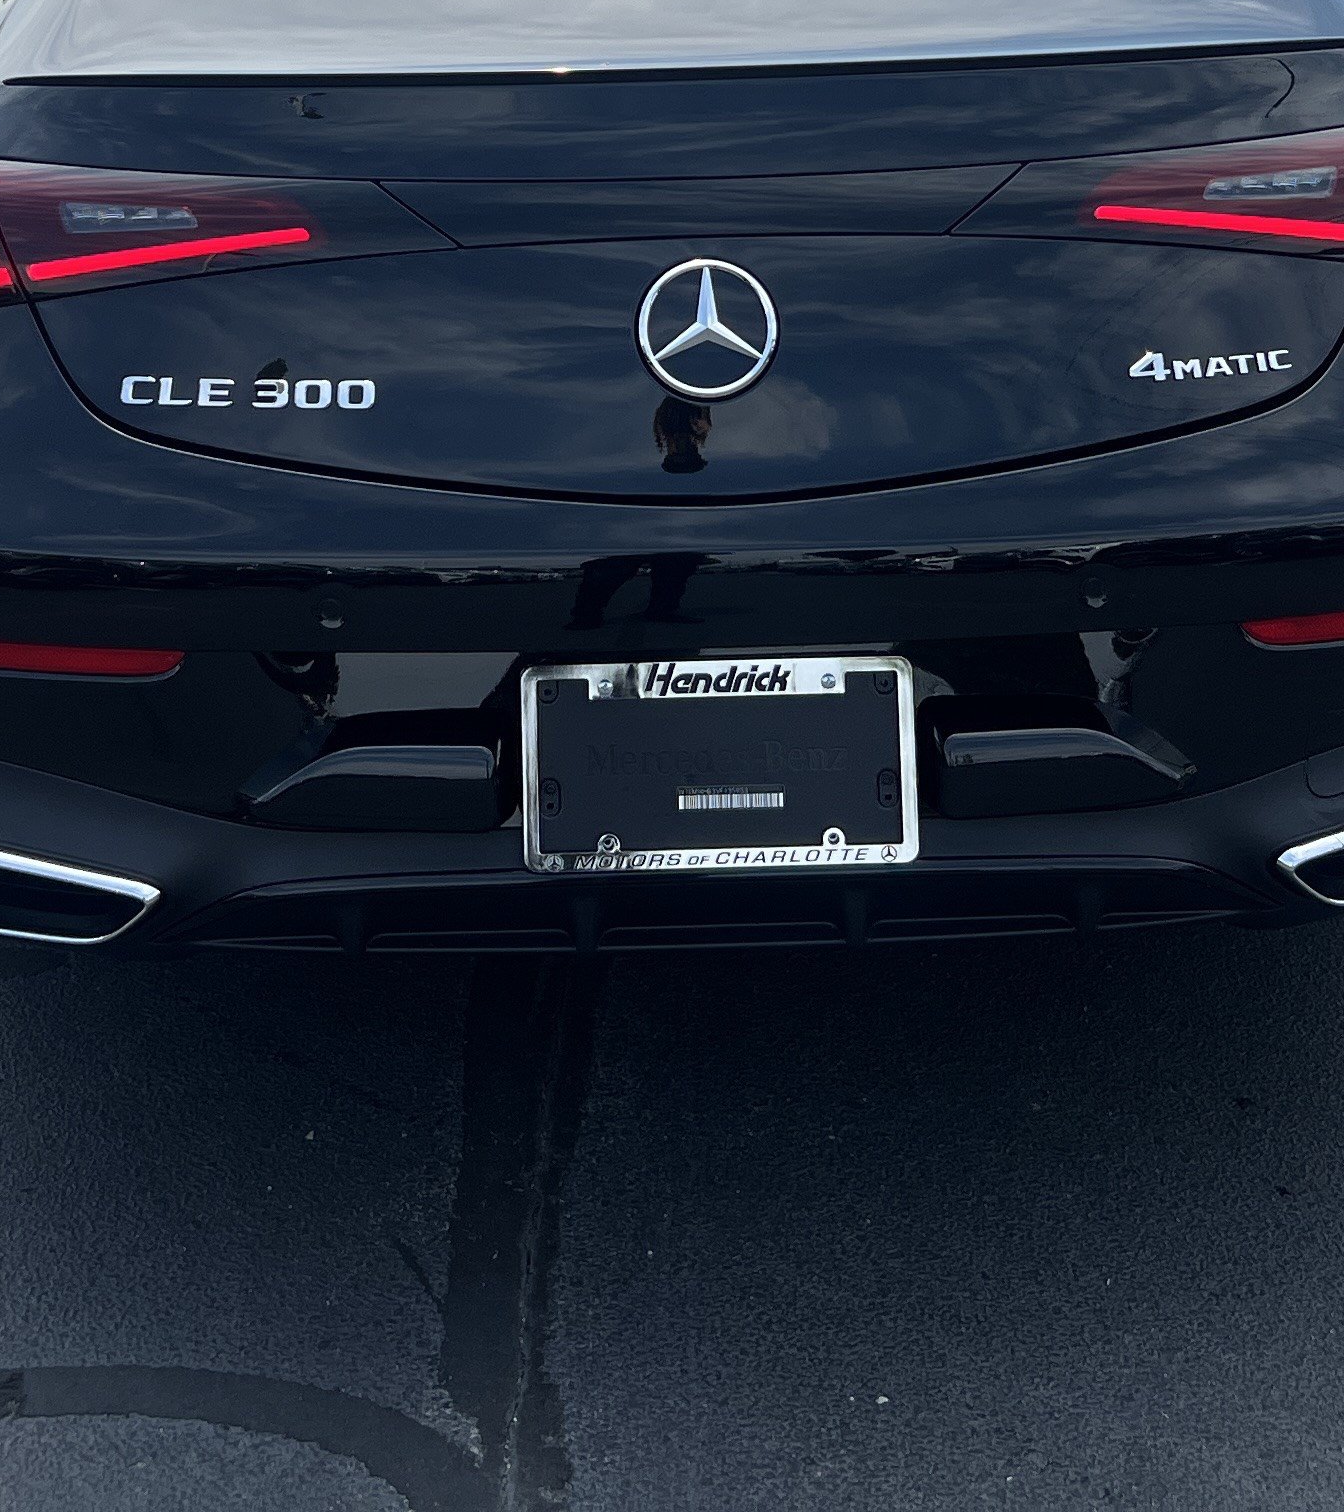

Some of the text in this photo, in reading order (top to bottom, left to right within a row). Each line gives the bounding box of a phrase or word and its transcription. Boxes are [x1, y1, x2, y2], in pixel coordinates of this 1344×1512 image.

[1129, 349, 1292, 381] 4MATIC
[120, 375, 376, 410] CLE 300
[644, 662, 792, 697] Hendrick
[573, 847, 871, 870] MOTORS OF CHARLOTTE
